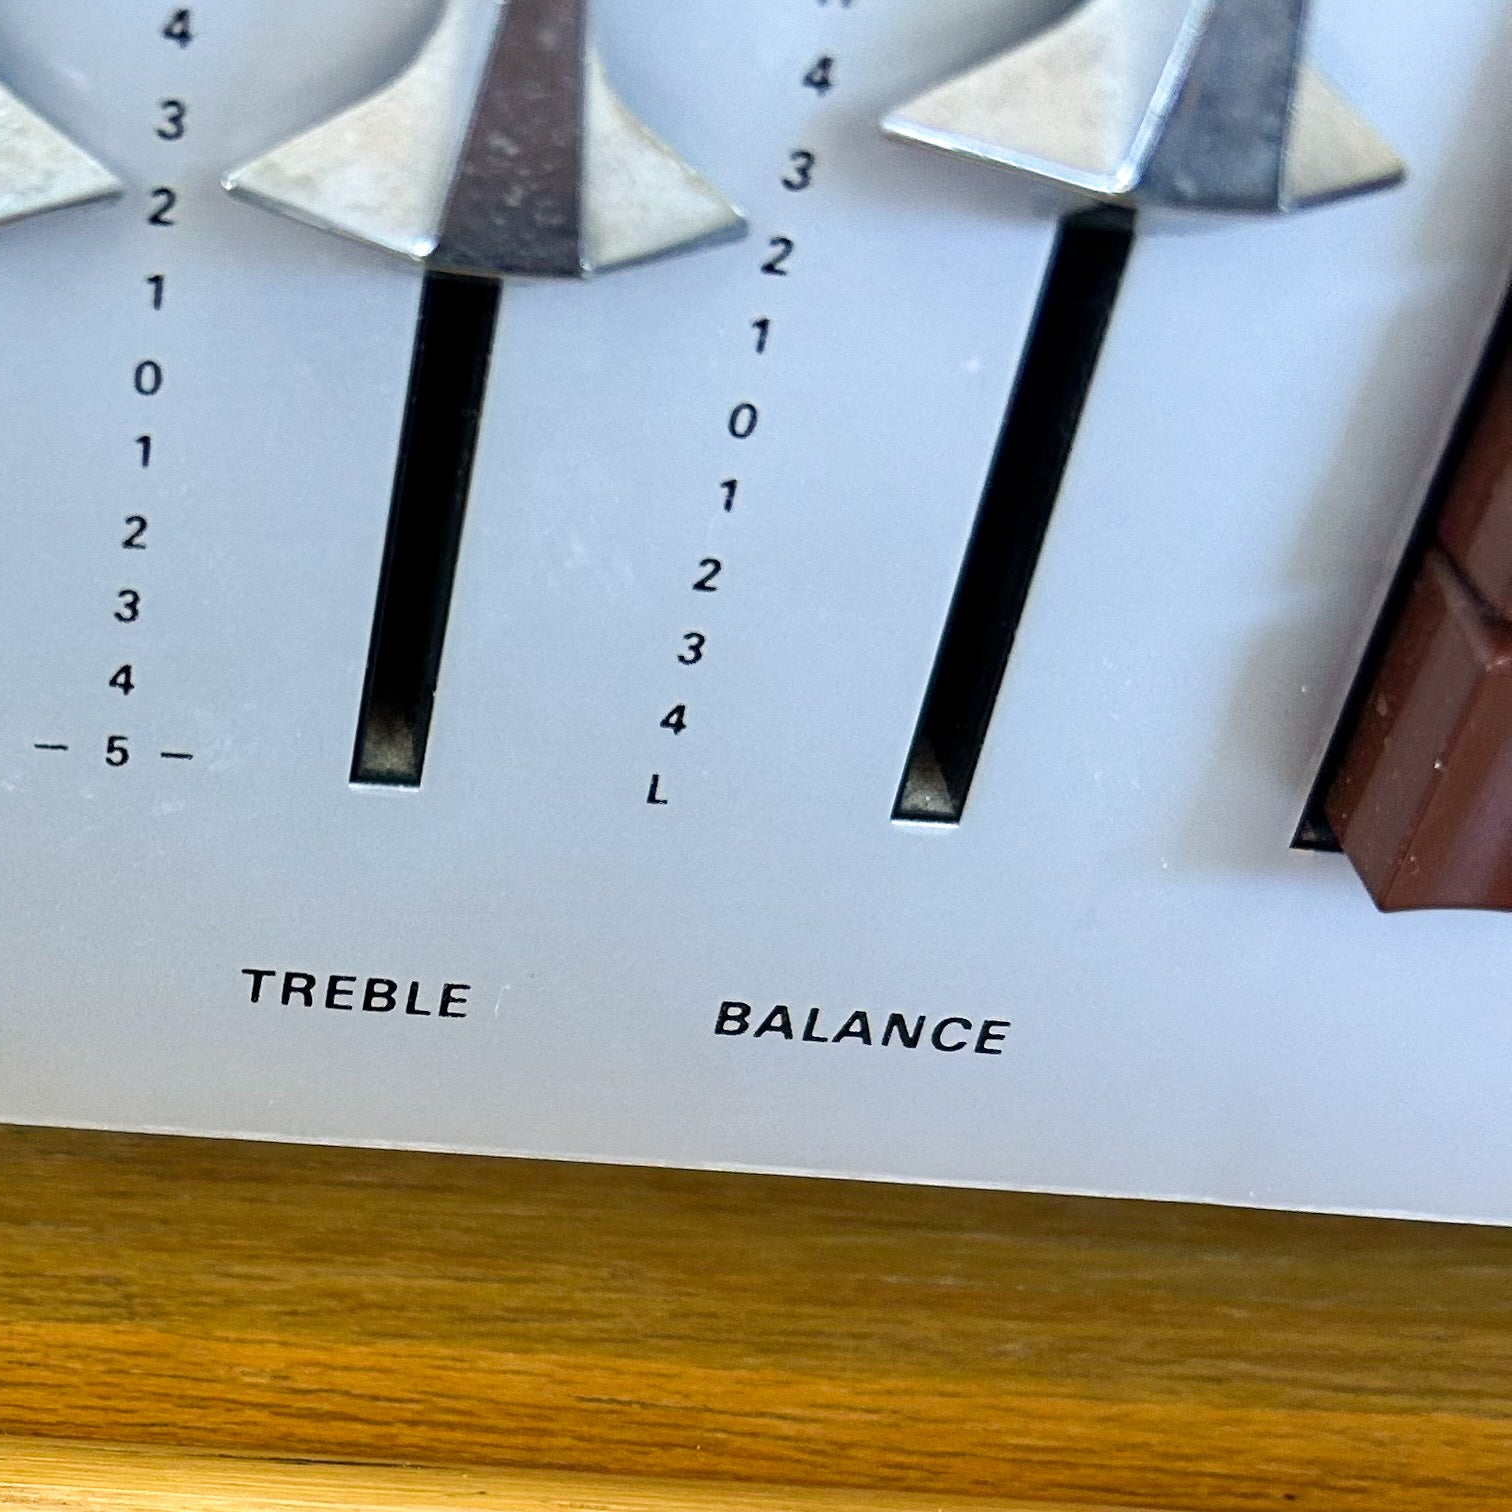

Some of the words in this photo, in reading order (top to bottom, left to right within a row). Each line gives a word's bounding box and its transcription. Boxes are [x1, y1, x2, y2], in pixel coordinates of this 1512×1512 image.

[161, 8, 194, 49] 4
[801, 54, 835, 97] 4
[155, 98, 187, 142] 3
[780, 148, 817, 193] 3
[146, 186, 177, 227] 2
[759, 235, 795, 277] 2
[146, 274, 165, 311] 1
[751, 317, 771, 355] 1
[133, 359, 164, 397] 0
[727, 402, 759, 440] 0
[134, 434, 152, 469] 1
[719, 478, 739, 513] 1
[121, 514, 149, 550] 2
[691, 557, 722, 593] 2
[113, 587, 141, 624] 3
[676, 631, 707, 667] 3
[108, 663, 136, 697] 4
[659, 703, 688, 736] 4
[646, 773, 669, 805] L
[239, 967, 473, 1020] TREBLE
[712, 999, 1013, 1056] BALANCE
